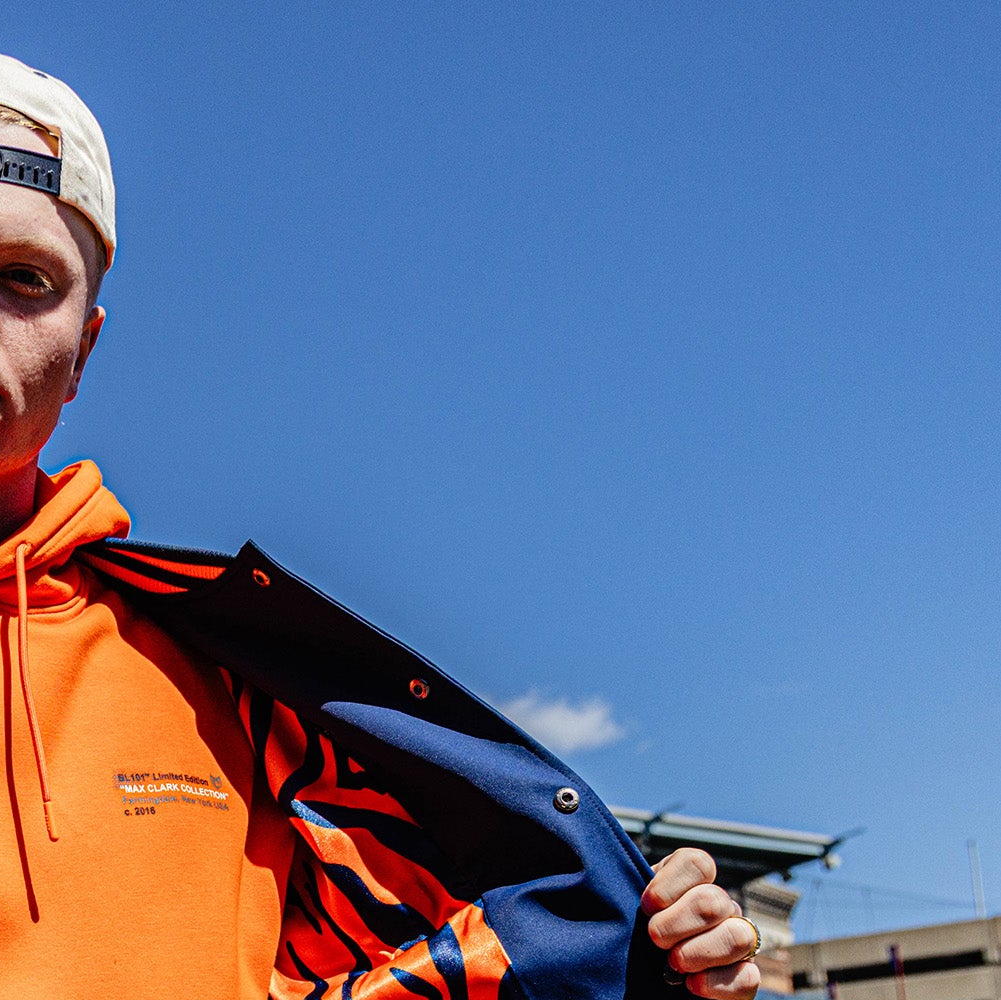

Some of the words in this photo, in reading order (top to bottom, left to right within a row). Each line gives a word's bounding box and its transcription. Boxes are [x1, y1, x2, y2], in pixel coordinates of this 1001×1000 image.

[152, 772, 183, 781] Limited
[184, 774, 209, 786] Edition
[147, 782, 180, 793] CLARK
